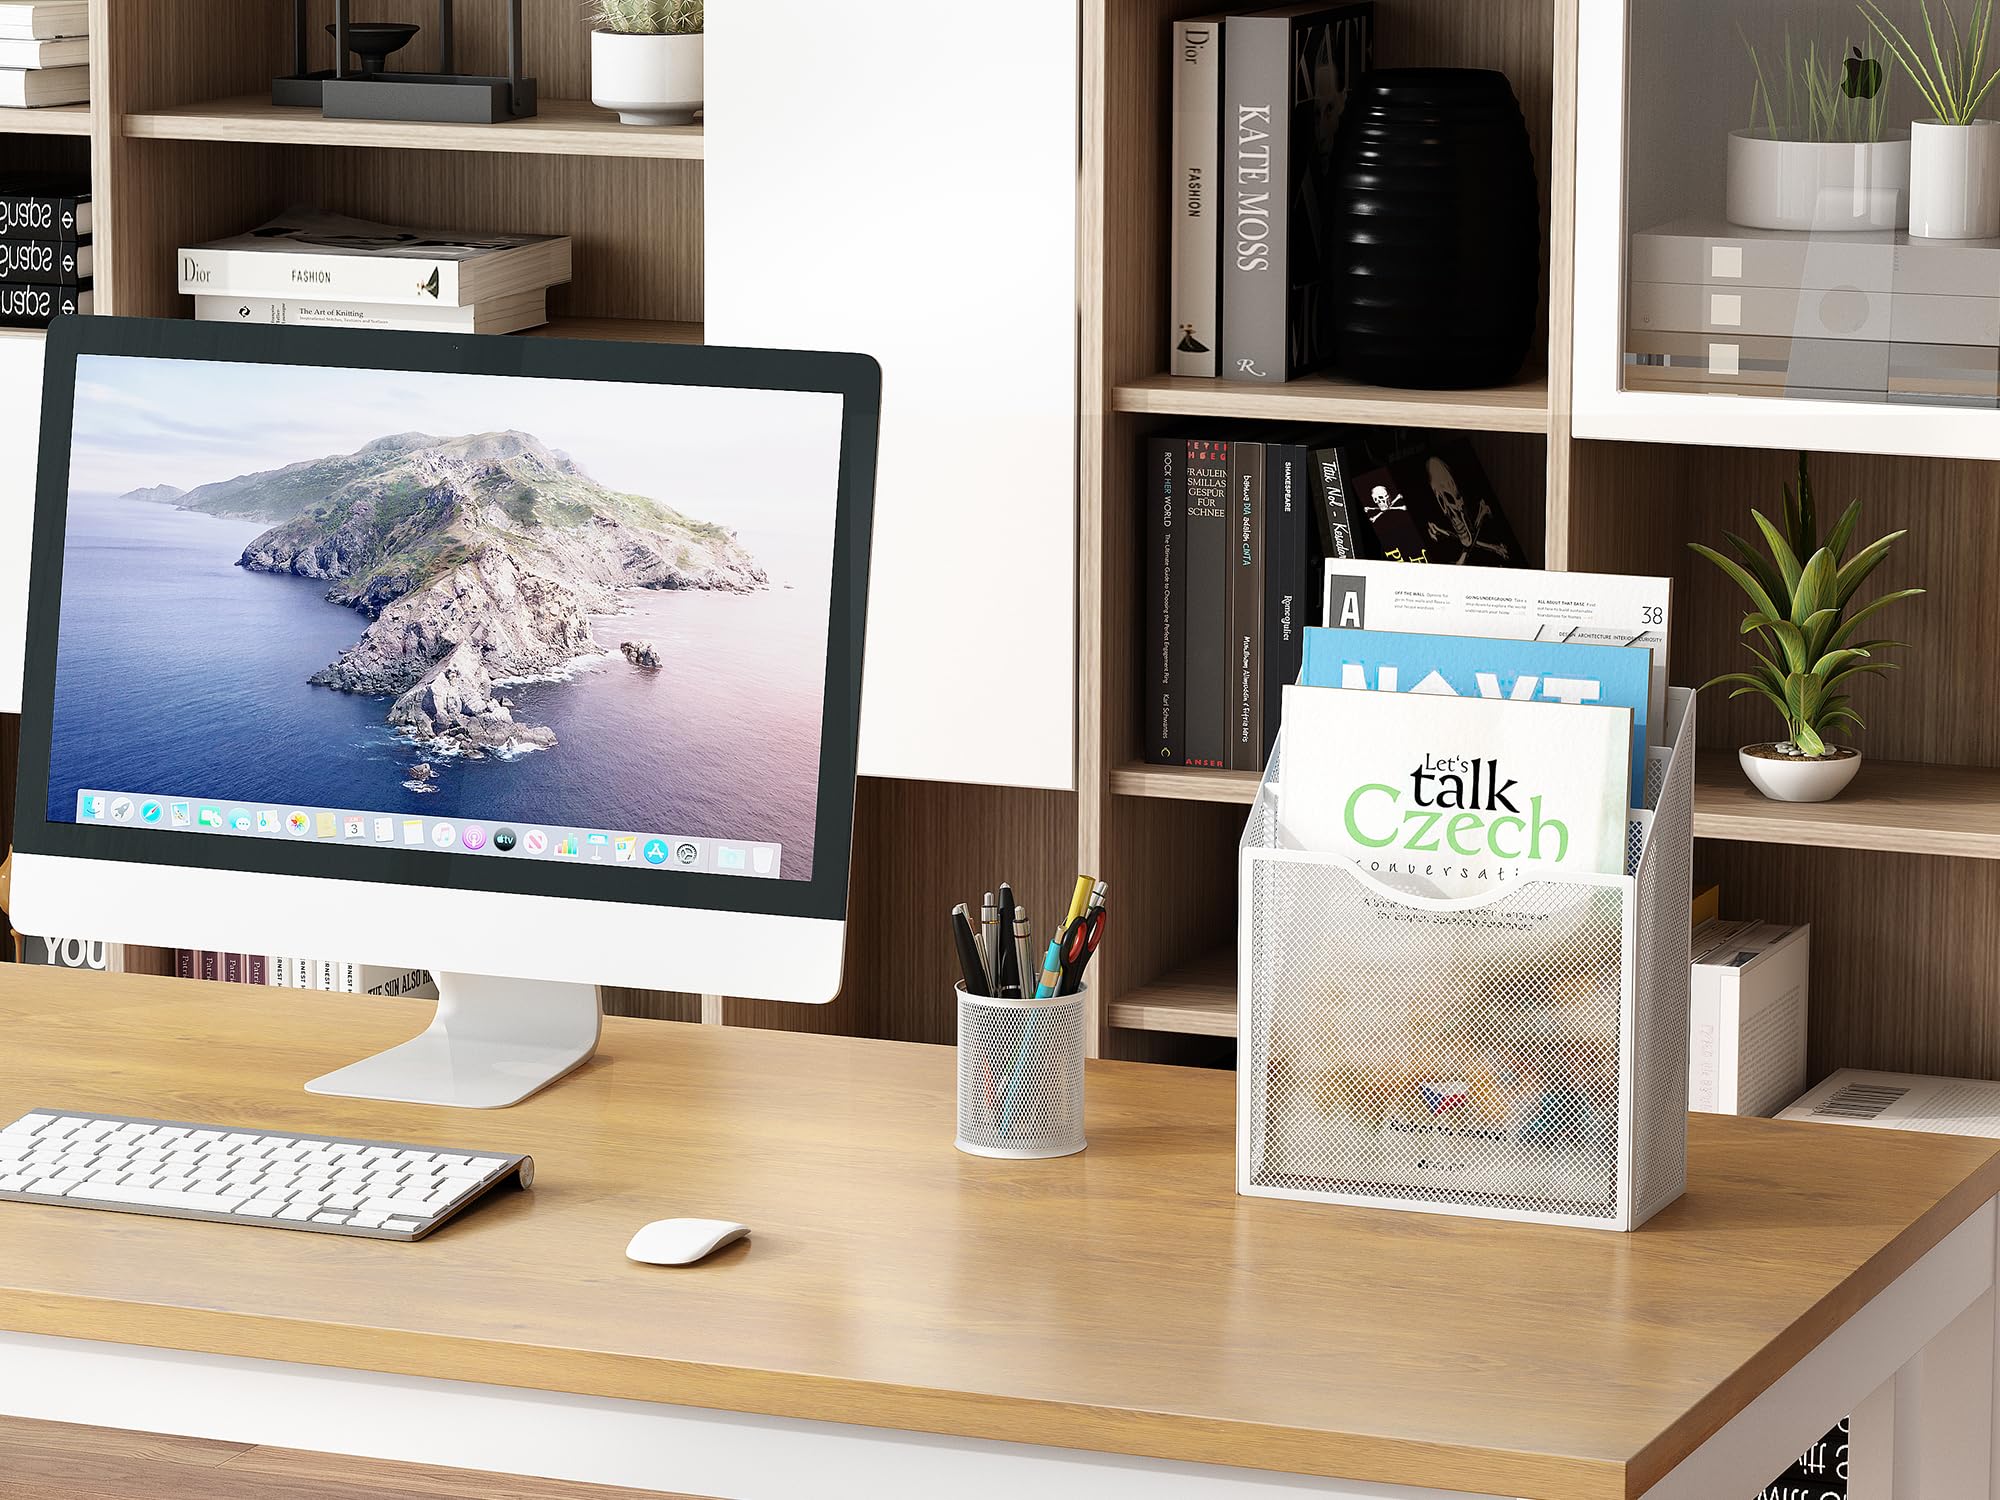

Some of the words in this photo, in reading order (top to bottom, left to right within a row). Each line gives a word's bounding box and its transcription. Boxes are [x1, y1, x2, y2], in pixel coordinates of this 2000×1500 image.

[1185, 29, 1209, 65] Dior
[1238, 103, 1270, 185] KATE
[1188, 167, 1202, 218] FASHION
[1236, 191, 1270, 271] MOSS
[183, 257, 211, 282] Dior
[291, 269, 332, 284] FASHION
[299, 307, 313, 315] The
[313, 308, 326, 316] Art
[335, 309, 364, 318] Knitting
[1163, 451, 1173, 477] ROCK
[1164, 478, 1172, 494] HER
[1187, 477, 1227, 488] SMILLAS
[1284, 461, 1292, 513] SHAKESPEARE
[1163, 495, 1172, 527] WORLD
[1187, 507, 1225, 518] SCHNEE
[1197, 497, 1216, 507] FÜR
[1641, 606, 1663, 625] 38
[1577, 632, 1612, 640] ARCHITECTURE
[1425, 752, 1469, 774] Let's
[1410, 758, 1521, 814] talk
[351, 823, 358, 835] 3
[1344, 783, 1569, 863] Czech
[1356, 859, 1519, 881] onversat
[43, 936, 106, 970] YOU
[229, 959, 237, 983] Patri
[253, 961, 261, 985] Patri
[384, 977, 400, 997] SUN
[401, 969, 421, 994] ALSO
